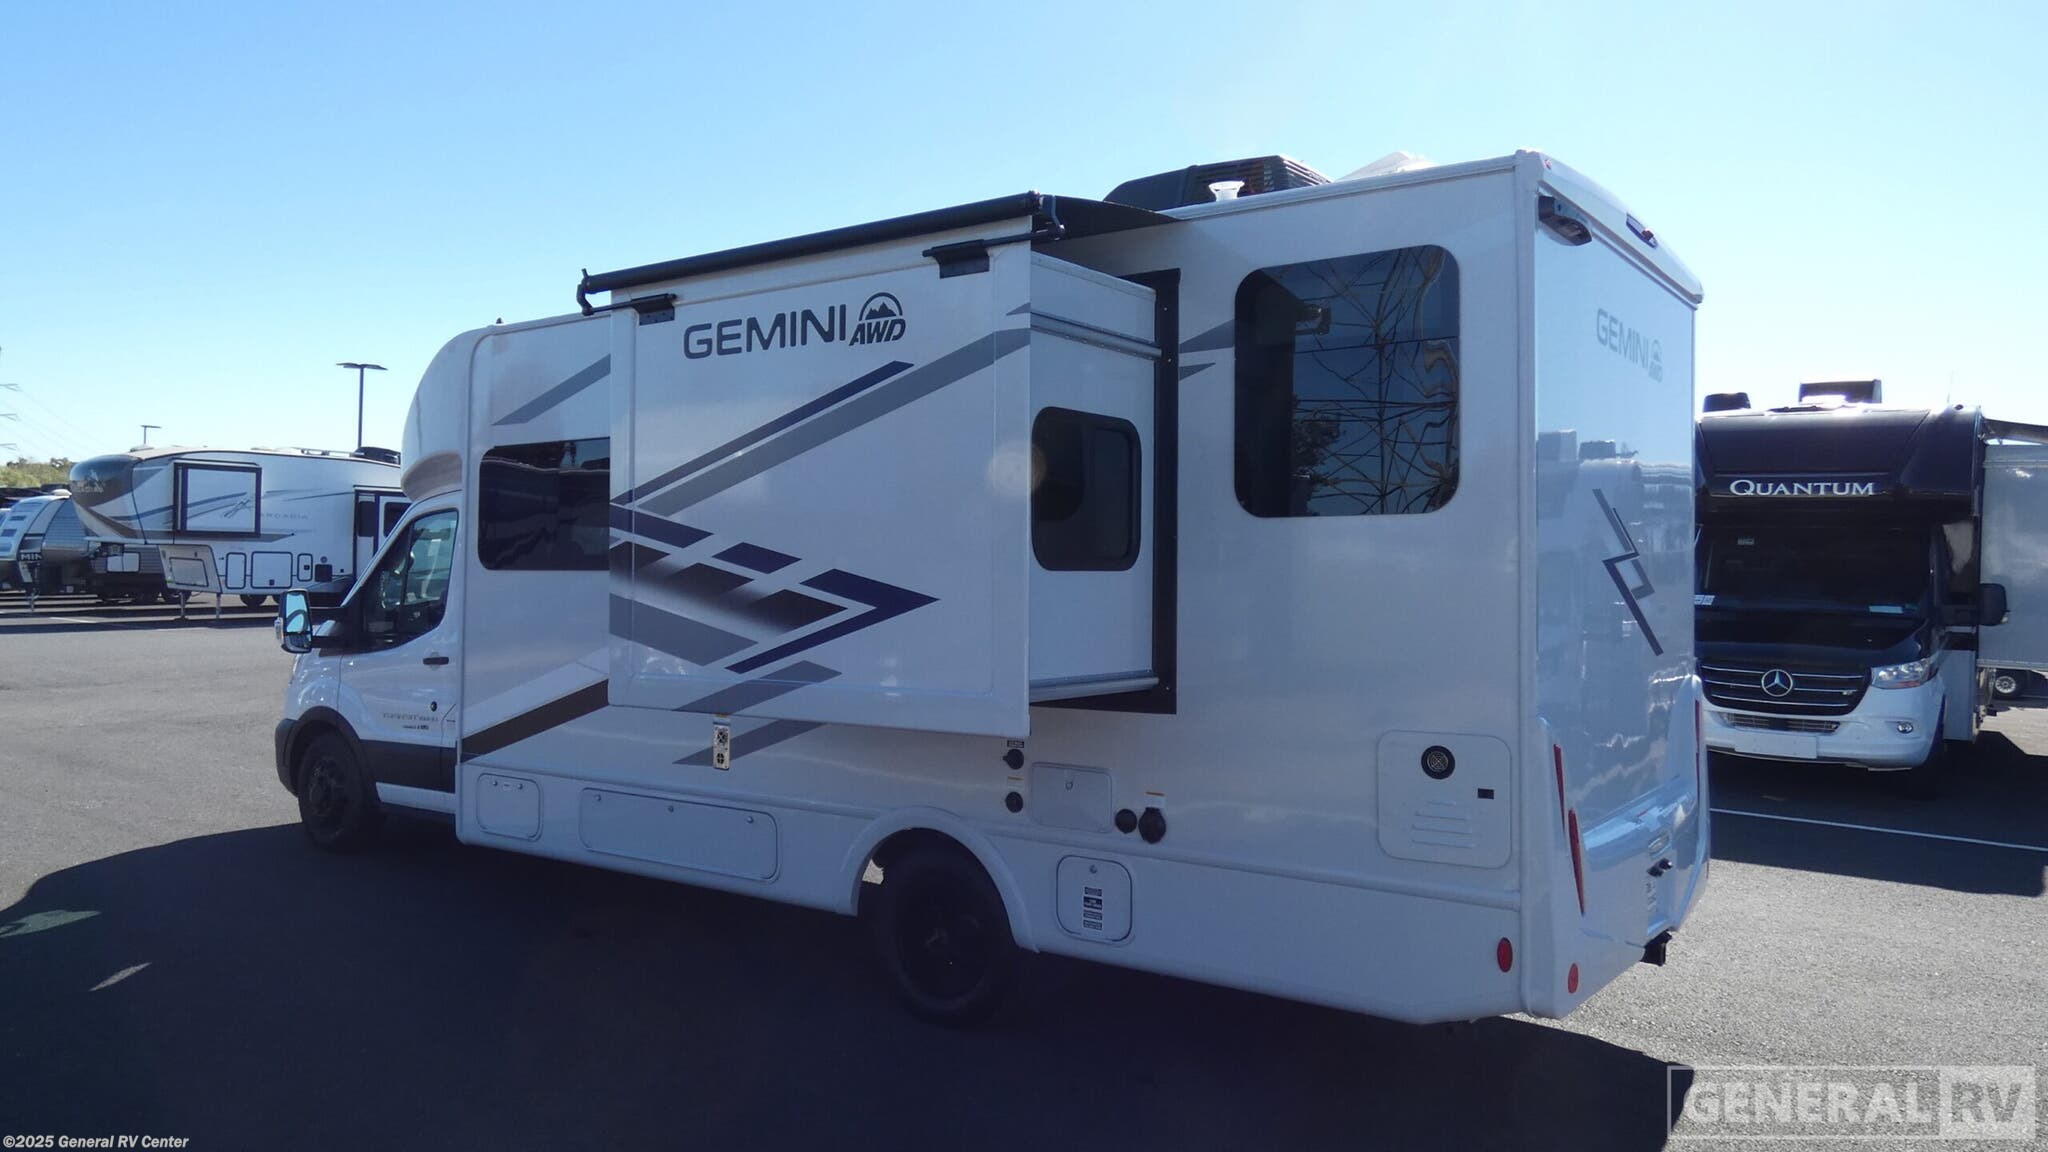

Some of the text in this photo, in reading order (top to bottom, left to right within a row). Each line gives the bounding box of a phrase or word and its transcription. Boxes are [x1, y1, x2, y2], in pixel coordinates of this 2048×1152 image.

[684, 304, 906, 360] GEMINI AWD
[1597, 308, 1649, 369] GEMINI
[1729, 479, 1875, 496] QUANTUM
